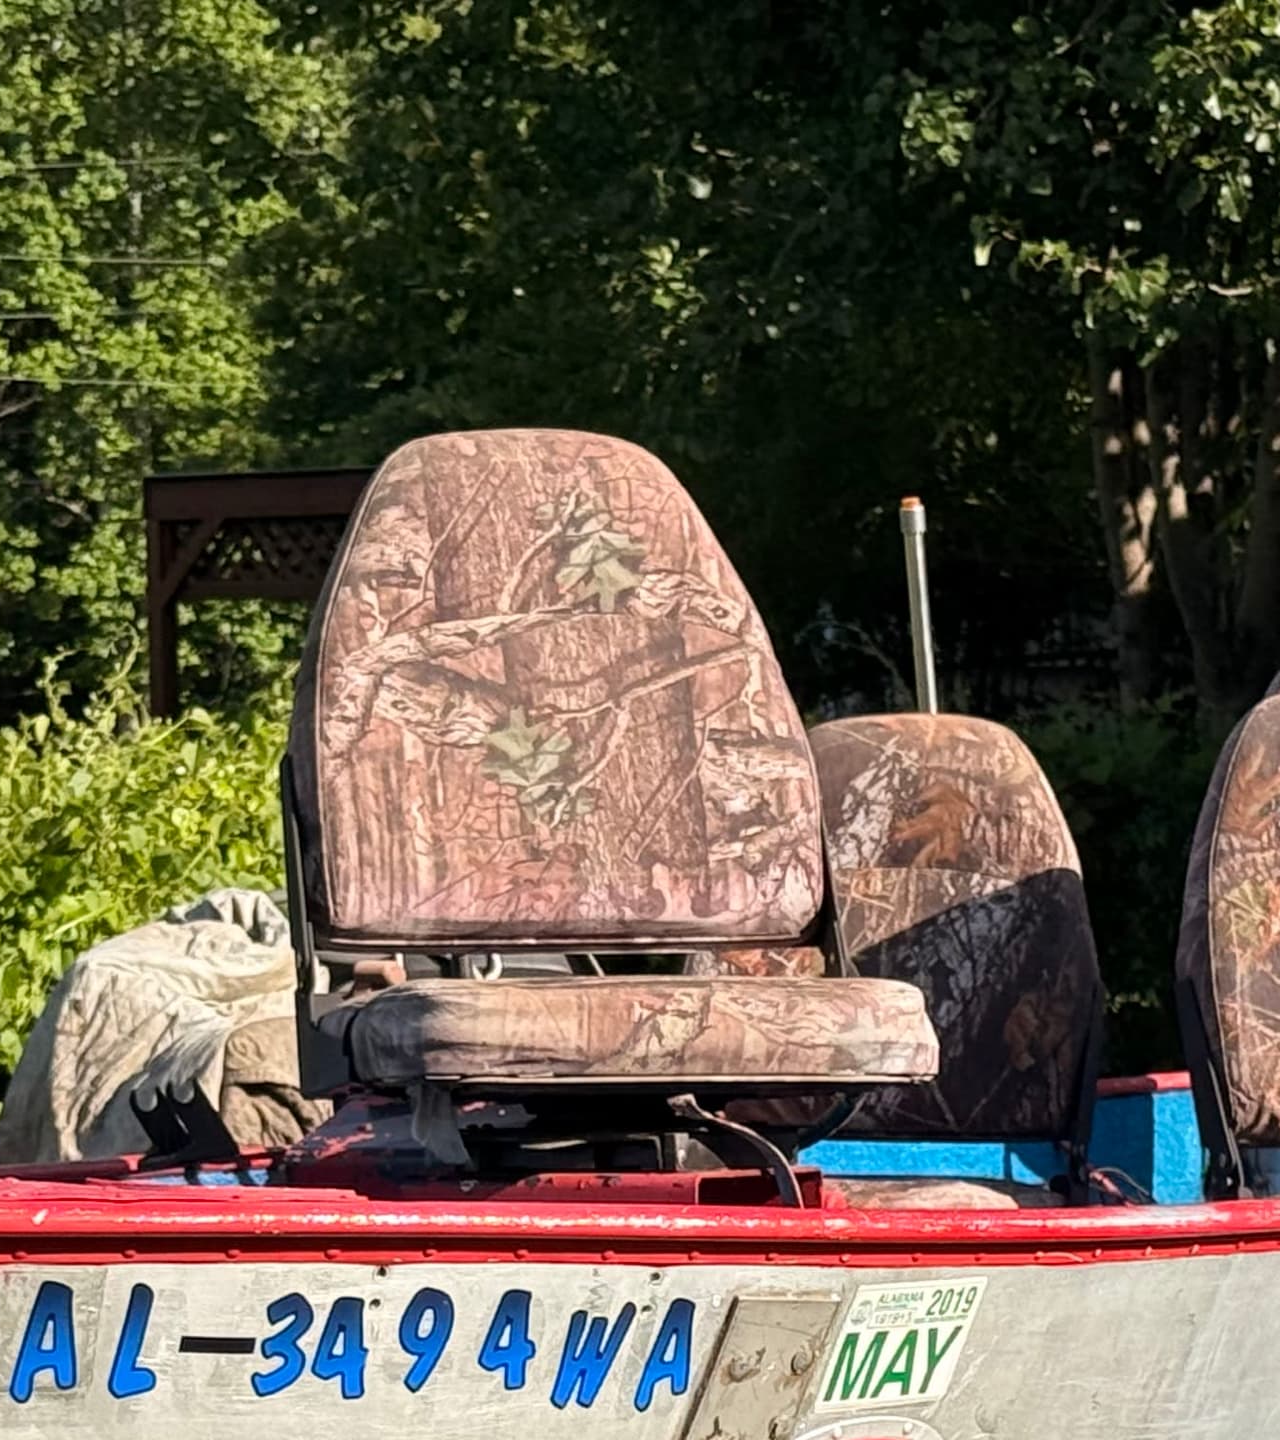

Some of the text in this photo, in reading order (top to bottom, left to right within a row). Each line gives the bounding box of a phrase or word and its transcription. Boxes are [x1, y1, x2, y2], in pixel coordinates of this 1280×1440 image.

[876, 1286, 978, 1317] ALABAMA 2019
[822, 1324, 964, 1403] MAY
